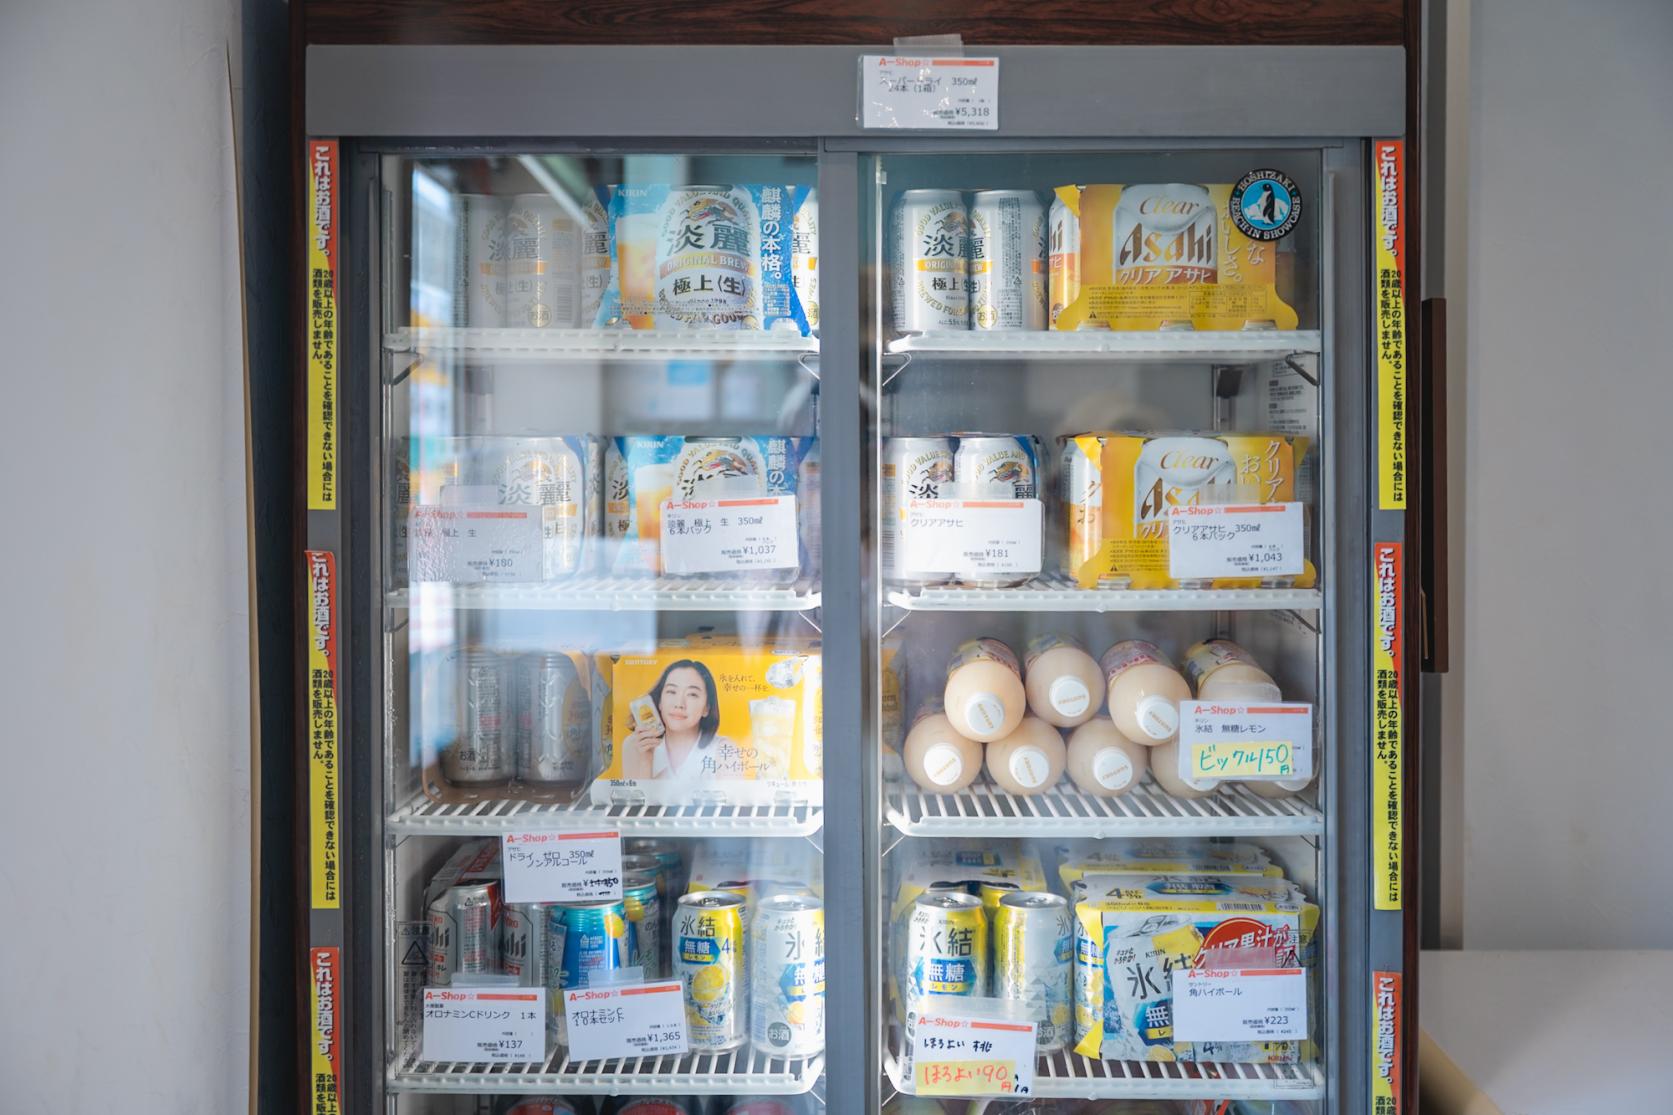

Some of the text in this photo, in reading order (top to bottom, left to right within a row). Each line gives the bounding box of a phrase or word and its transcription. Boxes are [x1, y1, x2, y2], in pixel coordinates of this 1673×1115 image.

[955, 107, 990, 117] ¥5,318
[1239, 170, 1296, 191] HOSHIZAKI
[618, 189, 648, 197] KIRIN
[314, 145, 331, 256] これはお酒です。
[1139, 194, 1201, 216] Clear
[1381, 146, 1398, 256] これはお酒です。
[1263, 196, 1301, 240] SHOWCASE
[761, 187, 783, 280] 麒麟の本格。
[1119, 222, 1213, 267] Asahi
[311, 268, 324, 365] 酒類を販売しません。
[1380, 268, 1392, 364] 酒類を販売しません。
[322, 269, 335, 502] 20歳以上の年齢であることを確認できない場合には
[1391, 270, 1403, 502] 20歳以上の年齢であることを確認できない場合には
[1160, 451, 1220, 470] Clear
[667, 501, 708, 510] A-Shop
[1172, 506, 1214, 516] A-Shop
[910, 518, 964, 528] クリアアサヒ
[1173, 525, 1226, 535] クリアアサヒ
[743, 545, 777, 556] ¥1,037
[985, 549, 1009, 558] ¥181
[489, 558, 513, 568] ¥180
[1249, 552, 1283, 563] ¥1,043
[1378, 547, 1396, 657] これはお酒です。
[1194, 705, 1236, 715] A-Shop
[311, 668, 324, 766] 酒類を販売しません。
[1377, 669, 1388, 764] 酒類を販売しません。
[1195, 724, 1267, 734] 氷結 無糖レモン
[322, 669, 336, 901] 20歳以上の年齢であることを確認できない場合には
[1388, 670, 1399, 901] 20歳以上の年齢であることを確認できない場合には
[507, 834, 548, 843] A-Shop
[509, 852, 534, 862] ドライ
[543, 852, 561, 860] ゼロ
[680, 914, 716, 937] 氷結
[684, 939, 710, 954] 無糖
[929, 963, 966, 982] 無糖
[1188, 969, 1230, 979] A-Shop
[425, 992, 466, 1001] A-Shop
[569, 991, 610, 1001] A-Shop
[1188, 987, 1243, 997] 角ハイボール
[316, 952, 334, 1061] これはお酒です。
[425, 1010, 511, 1020] オロナミンCドリンク
[1264, 1015, 1289, 1025] ¥223
[918, 1016, 960, 1028] A-Shop
[1378, 976, 1395, 1084] これはお酒です。
[647, 1031, 681, 1043] ¥1,365
[498, 1040, 523, 1049] ¥137
